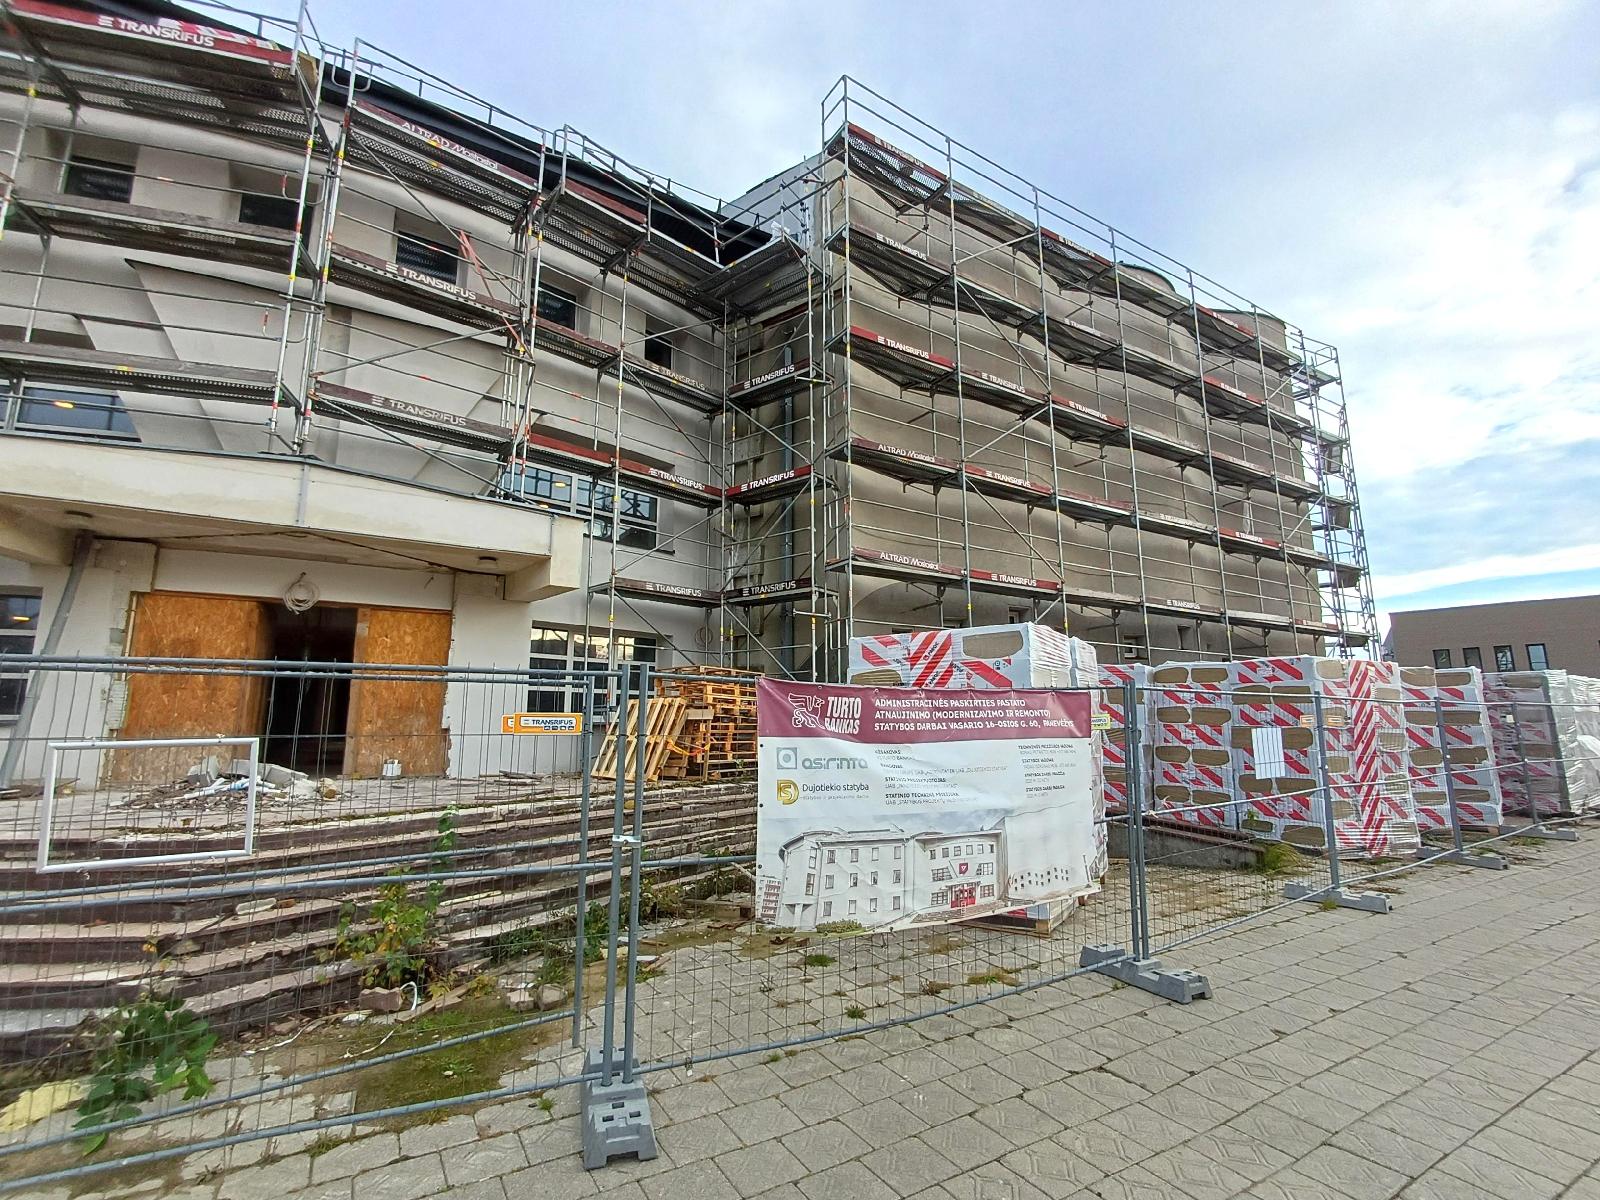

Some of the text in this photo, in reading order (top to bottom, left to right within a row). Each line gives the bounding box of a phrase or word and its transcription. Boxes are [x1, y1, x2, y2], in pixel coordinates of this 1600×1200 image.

[119, 17, 215, 47] TRANSRIFUS
[885, 235, 928, 261] TRANSRIFUS
[402, 267, 477, 300] TRANSRIFUS
[887, 338, 930, 359] TRANSRIFUS
[752, 364, 795, 386] TRANSRIFUS
[989, 374, 1026, 393] TRANSRIFUS
[389, 400, 467, 426] TRANSRIFUS
[877, 443, 907, 457] ALTRAD
[659, 471, 705, 491] TRANSRIFUS
[749, 470, 795, 490] TRANSRIFUS
[994, 471, 1031, 487] TRANSRIFUS
[879, 551, 910, 565] ALTRAD
[751, 581, 797, 595] TRANSRIFUS
[999, 573, 1037, 587] TRANSRIFUS
[655, 583, 702, 598] TRANSRIFUS
[826, 696, 862, 719] TURTO
[874, 698, 949, 708] ADMINISTRACINĖS
[950, 699, 996, 708] PASKIRTIES
[874, 710, 931, 720] ATNAUJINIMO
[932, 710, 1005, 720] (MODERNIZAVIMO
[1006, 709, 1015, 718] IR
[824, 717, 861, 735] BANKAS
[874, 722, 915, 731] STATYBOS
[916, 722, 948, 731] DARBAI
[948, 721, 984, 730] VASARIO
[986, 720, 1019, 729] 16-OSIOS
[802, 781, 870, 794] Dujotiekio statyba
